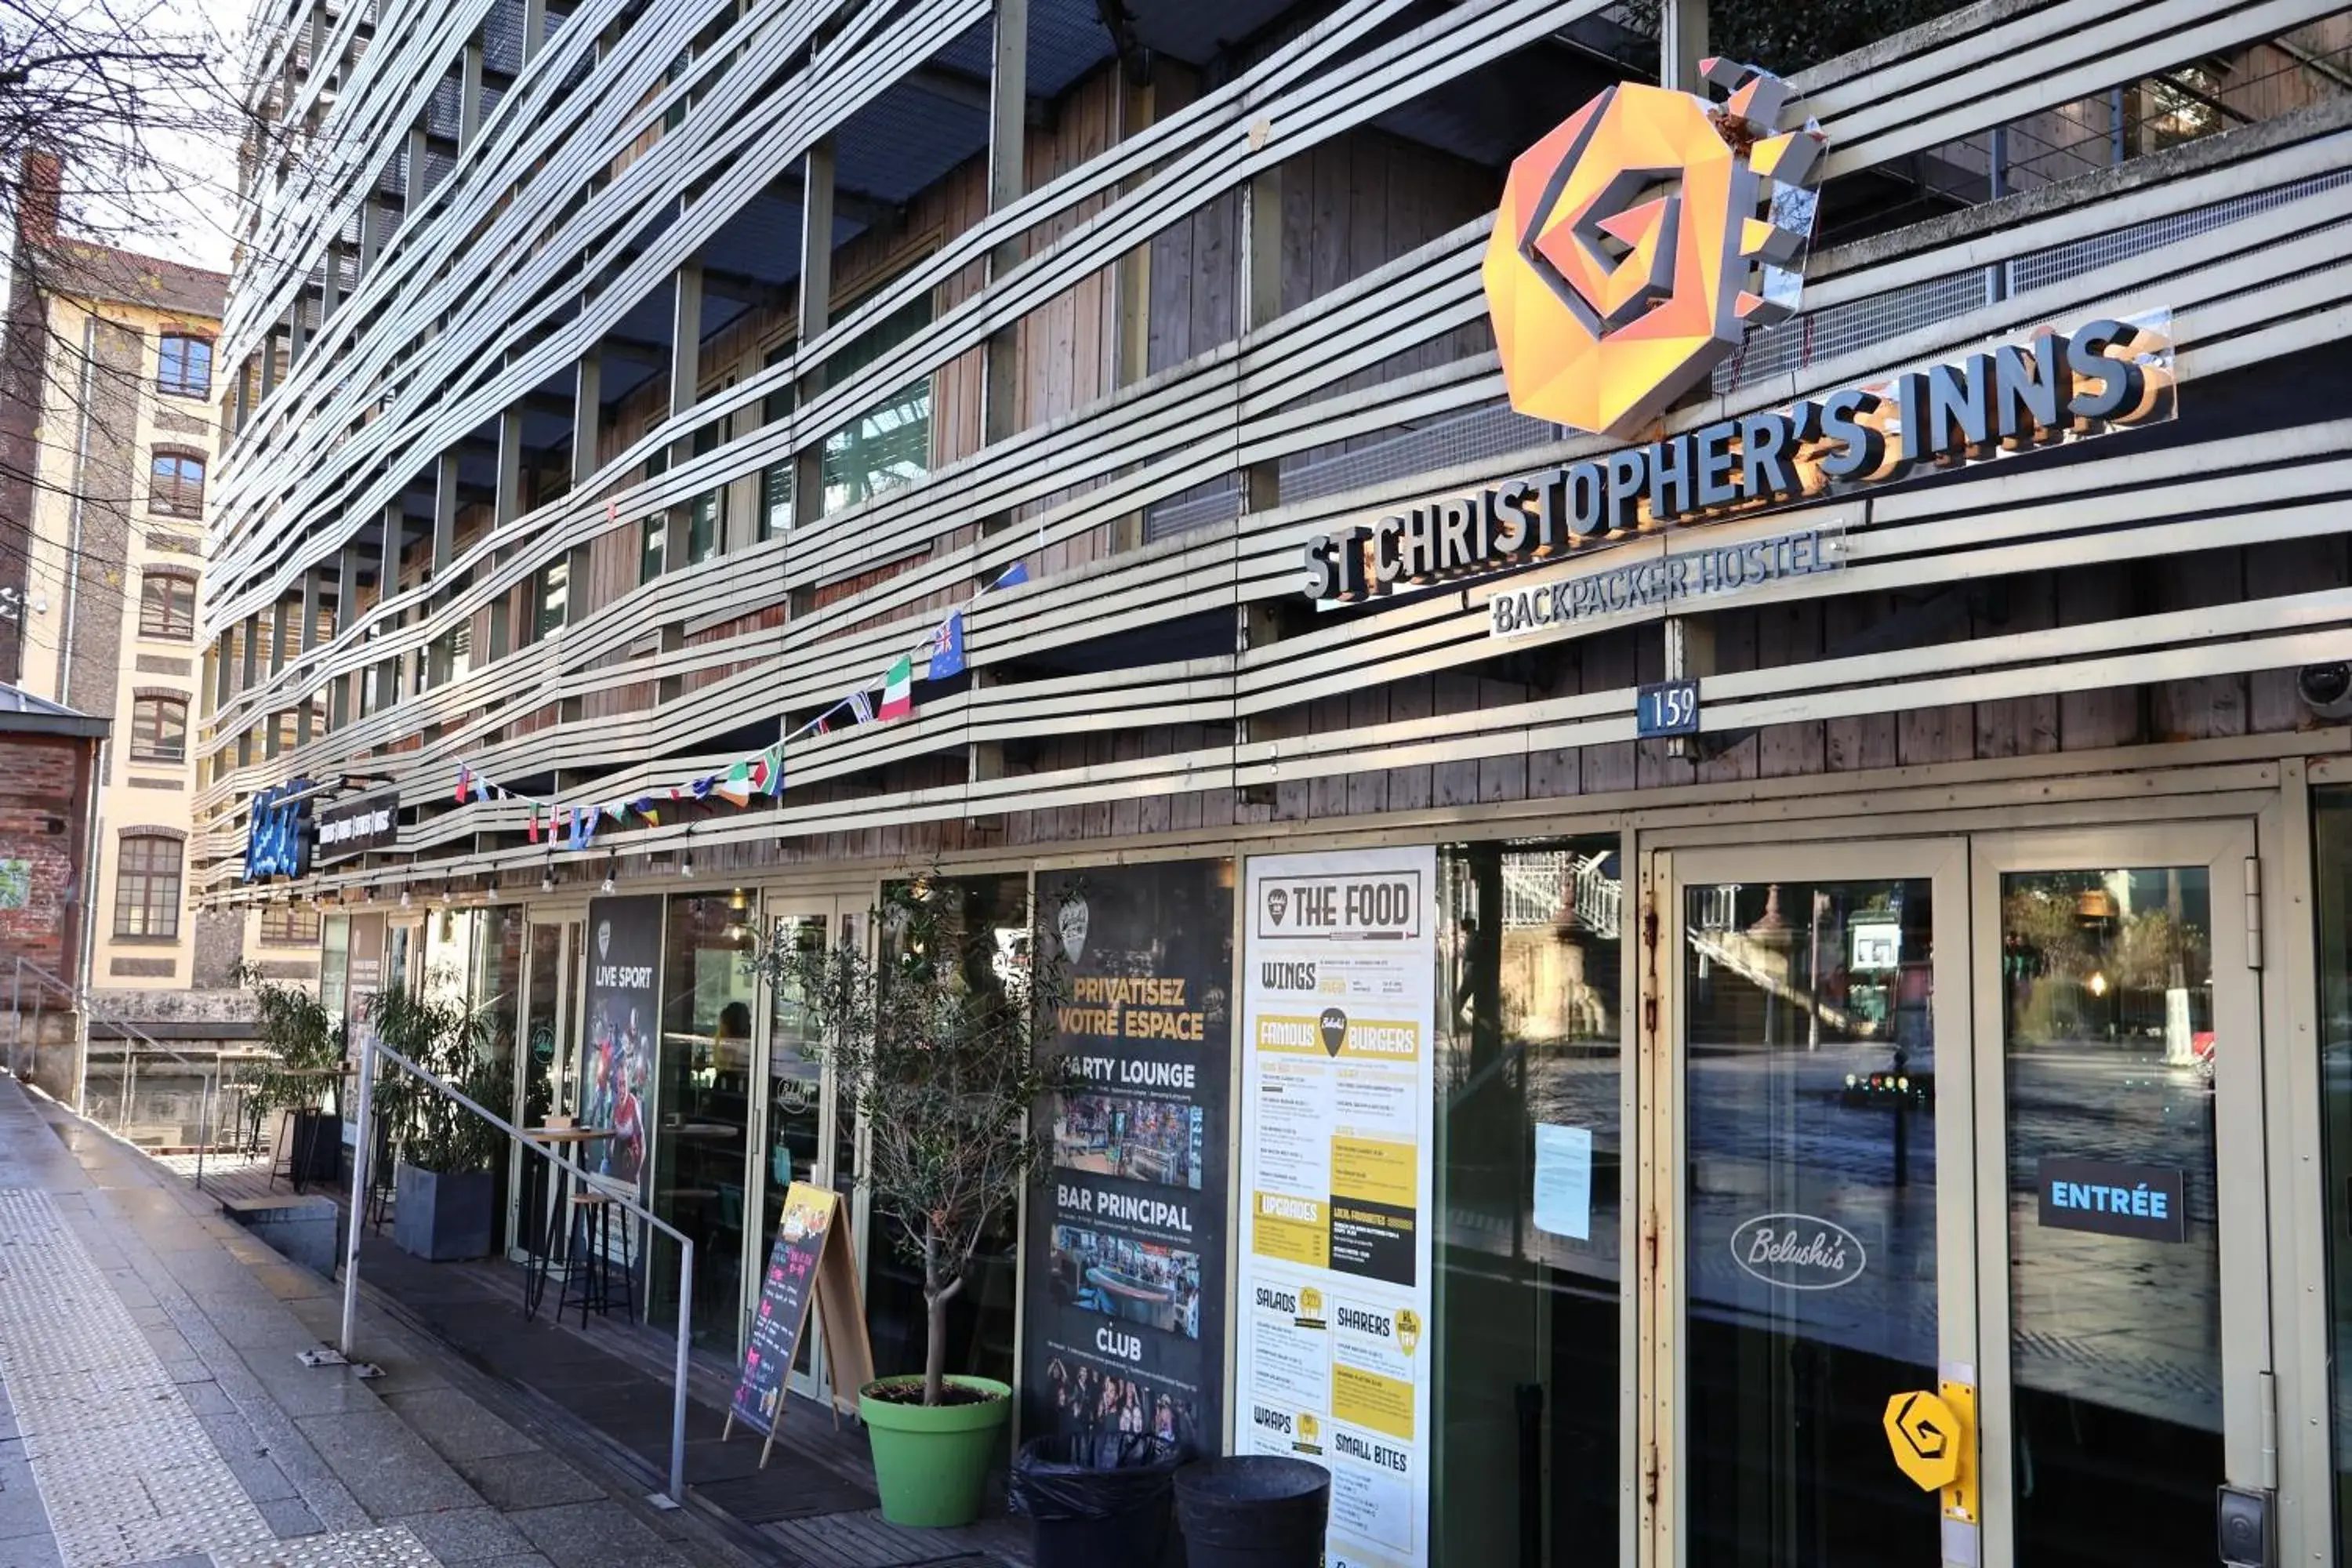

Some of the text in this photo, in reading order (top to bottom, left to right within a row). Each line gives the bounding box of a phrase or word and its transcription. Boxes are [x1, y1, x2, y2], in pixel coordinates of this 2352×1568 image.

[1304, 318, 2143, 601] ST CHRISTOPHER'S INNS
[1494, 530, 1835, 633] BACKPACKER HOSTEL
[1653, 688, 1694, 728] 159
[1293, 883, 1410, 927] THE FOOD
[596, 965, 652, 989] LIVE SPORT
[1074, 978, 1185, 1006] PRIVATISEZ
[1261, 961, 1316, 990] WINGS
[1058, 1007, 1204, 1041] VOTRE ESPACE
[1261, 1022, 1315, 1047] FAMOUS
[1348, 1026, 1414, 1053] BURGERS
[1120, 1060, 1196, 1088] LOUNGE
[1058, 1183, 1092, 1213] BAR
[1098, 1191, 1192, 1232] PRINCIPAL
[1261, 1193, 1318, 1221] UPGRADES
[2052, 1181, 2168, 1218] ENTRÉE
[1748, 1228, 1846, 1270] Belushi's
[1256, 1287, 1296, 1314] SALADS
[1337, 1306, 1390, 1338] SHARERS
[1097, 1327, 1142, 1361] CLUB
[1254, 1404, 1292, 1435] WRAPS
[1335, 1432, 1372, 1463] SMALL
[1374, 1445, 1407, 1472] BITES
